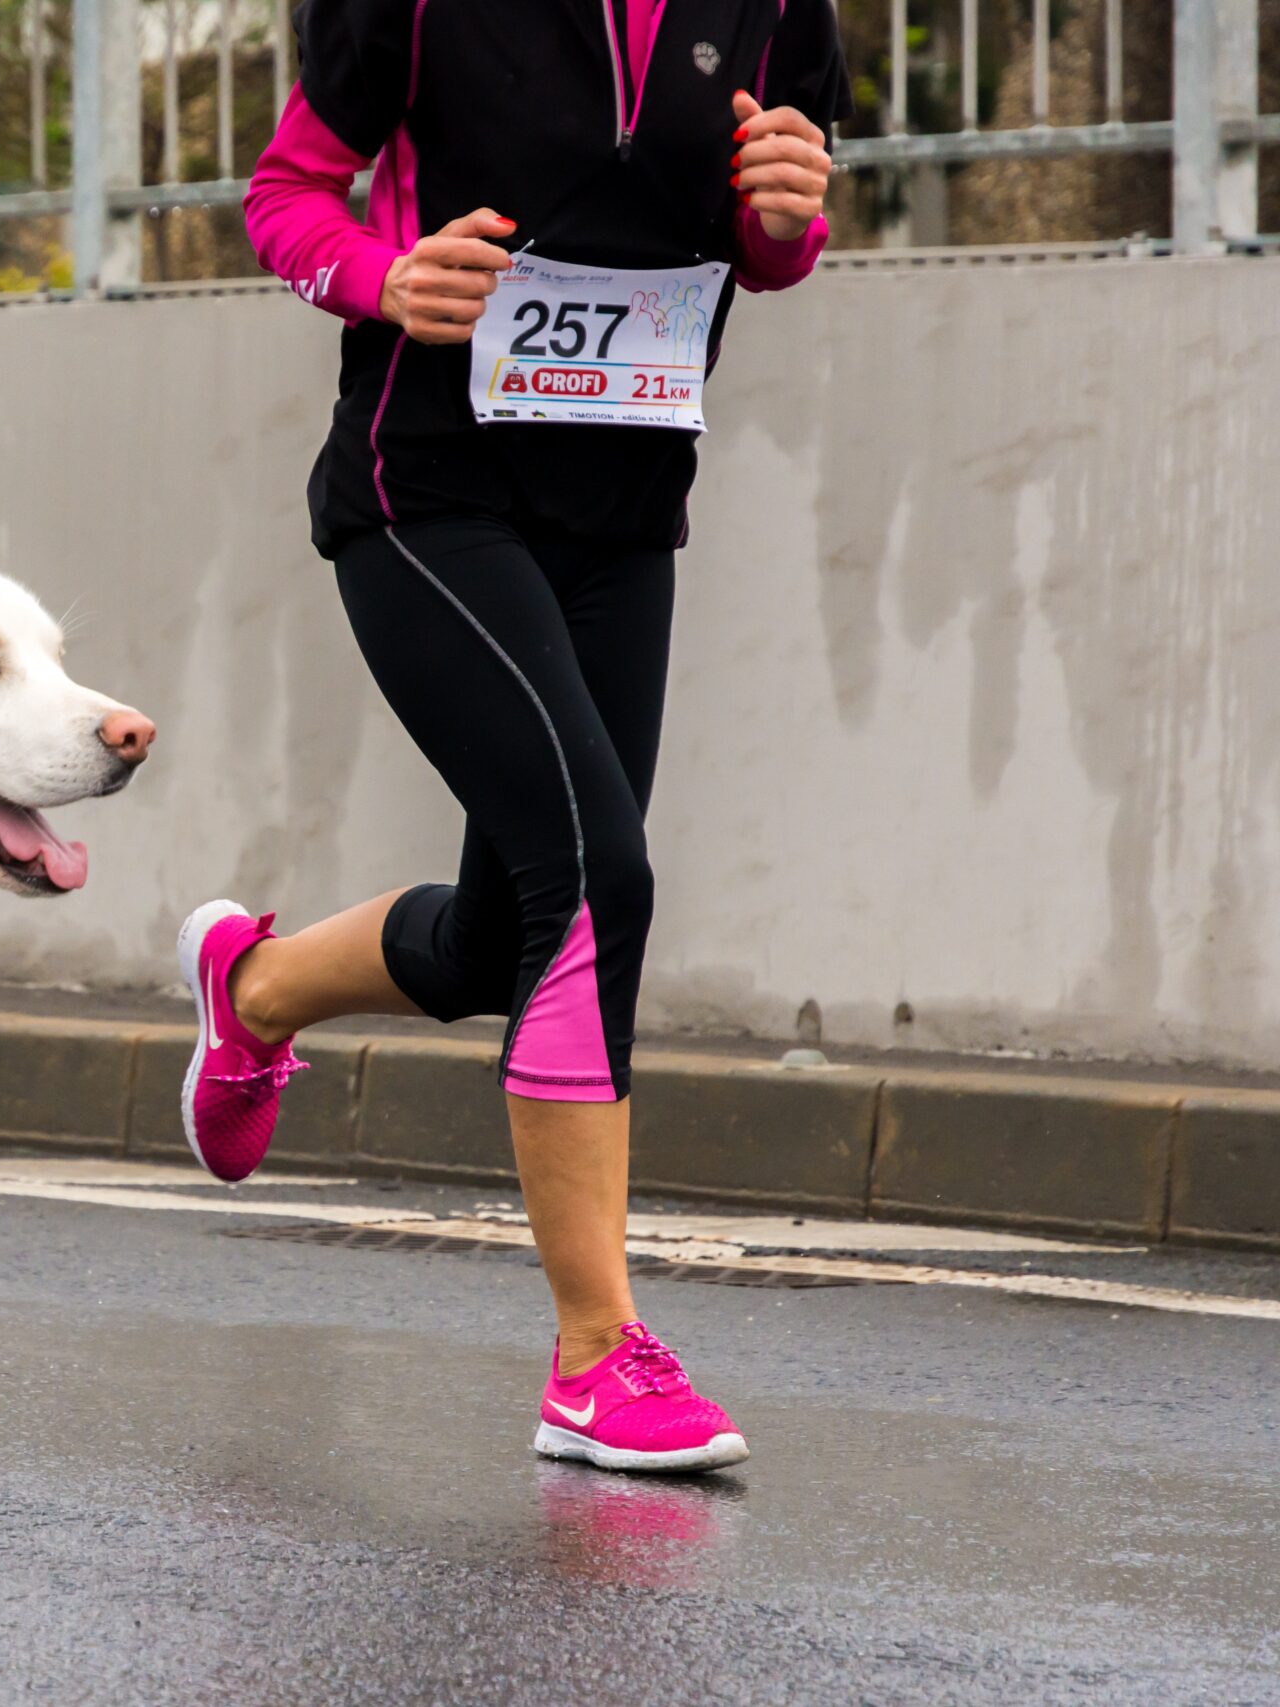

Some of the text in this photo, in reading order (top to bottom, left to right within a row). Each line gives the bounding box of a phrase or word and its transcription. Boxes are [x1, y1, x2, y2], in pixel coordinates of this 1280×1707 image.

[510, 300, 630, 359] 257
[538, 371, 601, 394] PROFI
[632, 373, 690, 400] 21 KM
[568, 412, 614, 420] TIMOTION
